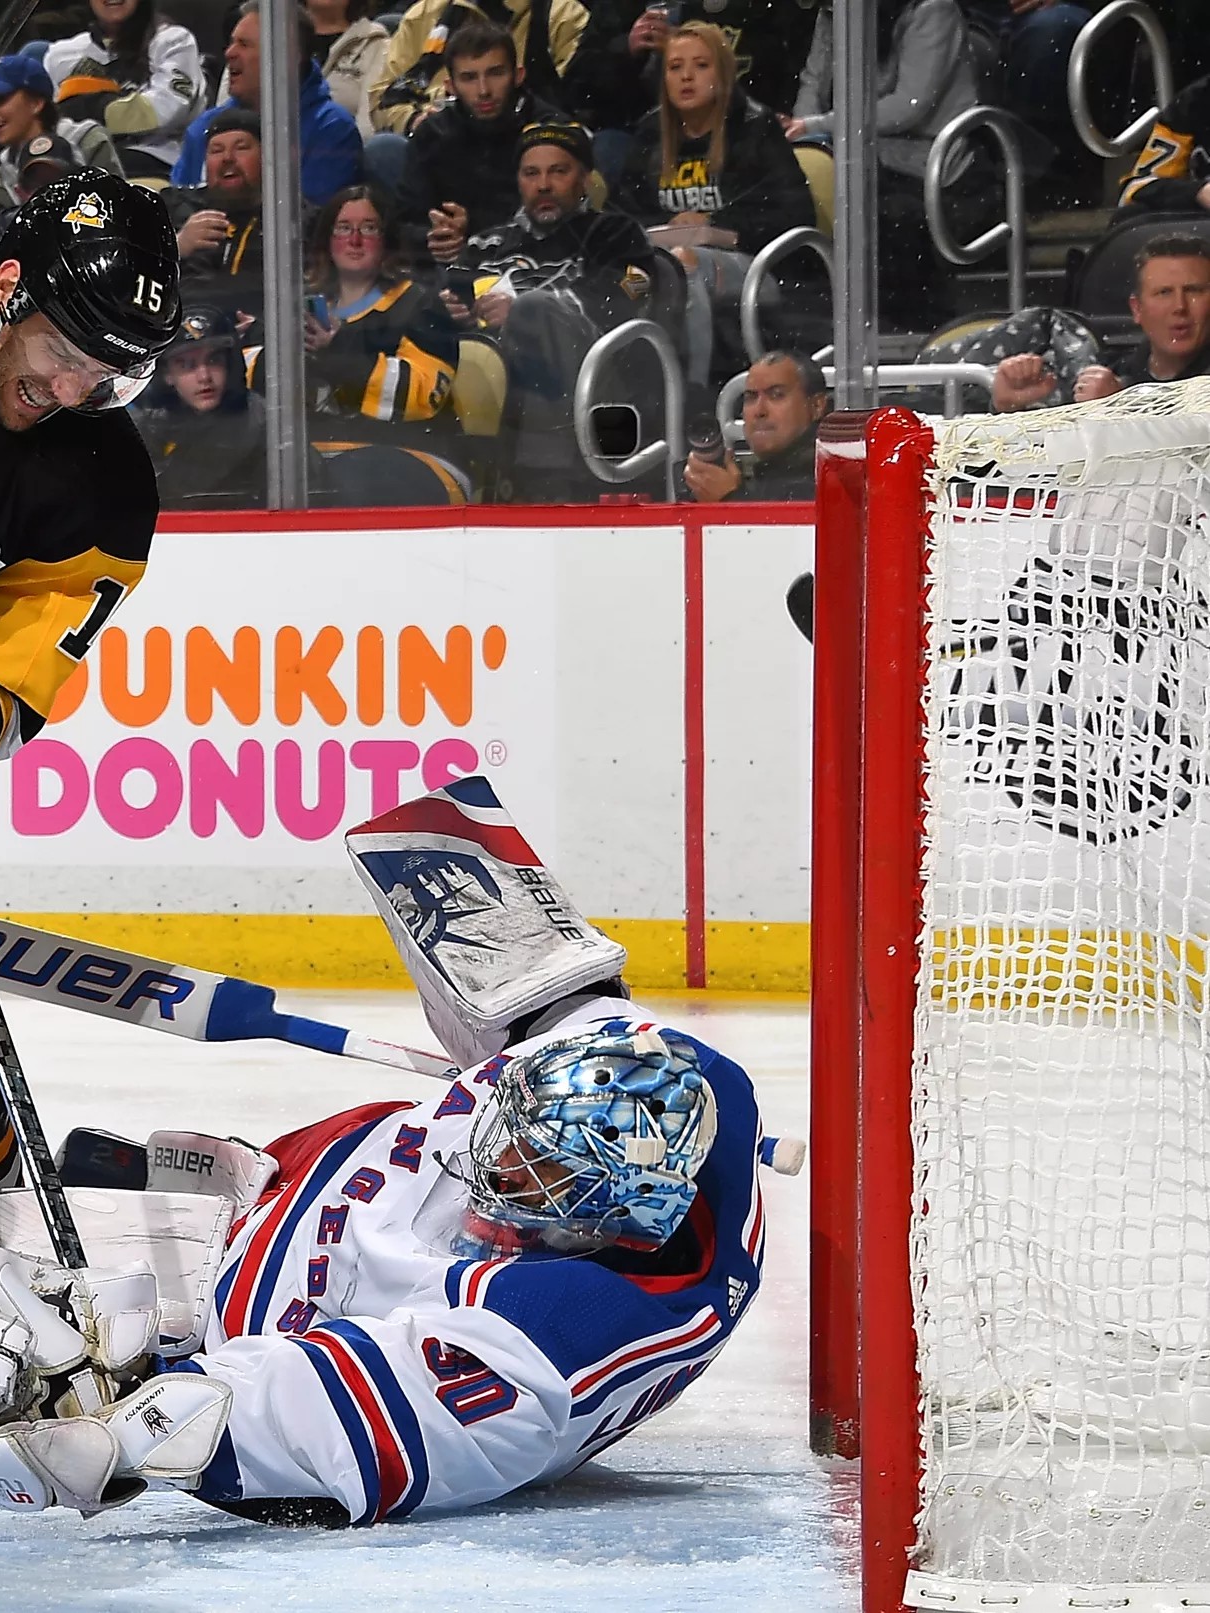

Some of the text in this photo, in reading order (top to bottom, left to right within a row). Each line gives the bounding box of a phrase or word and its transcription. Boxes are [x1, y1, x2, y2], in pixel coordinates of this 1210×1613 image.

[132, 273, 164, 313] 15
[103, 333, 148, 355] BAUER
[514, 868, 599, 950] BAUER
[154, 1144, 216, 1177] BAUER
[420, 1336, 519, 1428] 30
[124, 1386, 166, 1423] LUNDQVIST
